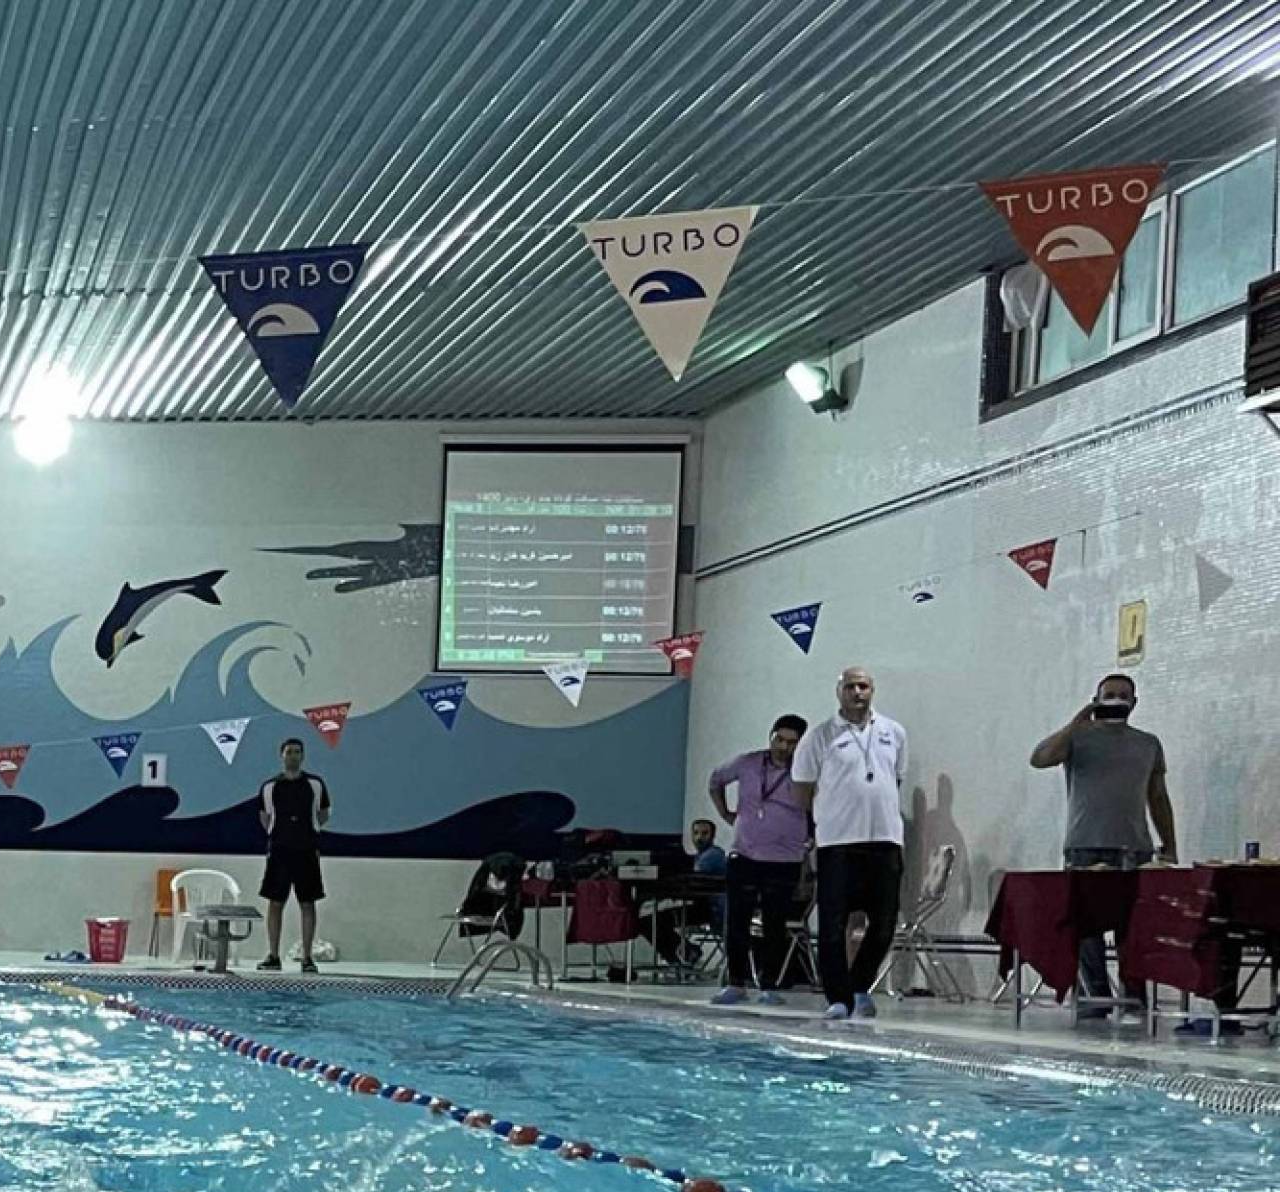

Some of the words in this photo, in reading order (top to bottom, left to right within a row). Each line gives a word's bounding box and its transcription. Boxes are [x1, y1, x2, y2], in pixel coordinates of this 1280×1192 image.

[996, 179, 1148, 217] TURBO
[592, 223, 740, 259] TURBO
[213, 260, 353, 292] TURBO
[147, 760, 157, 779] 1
